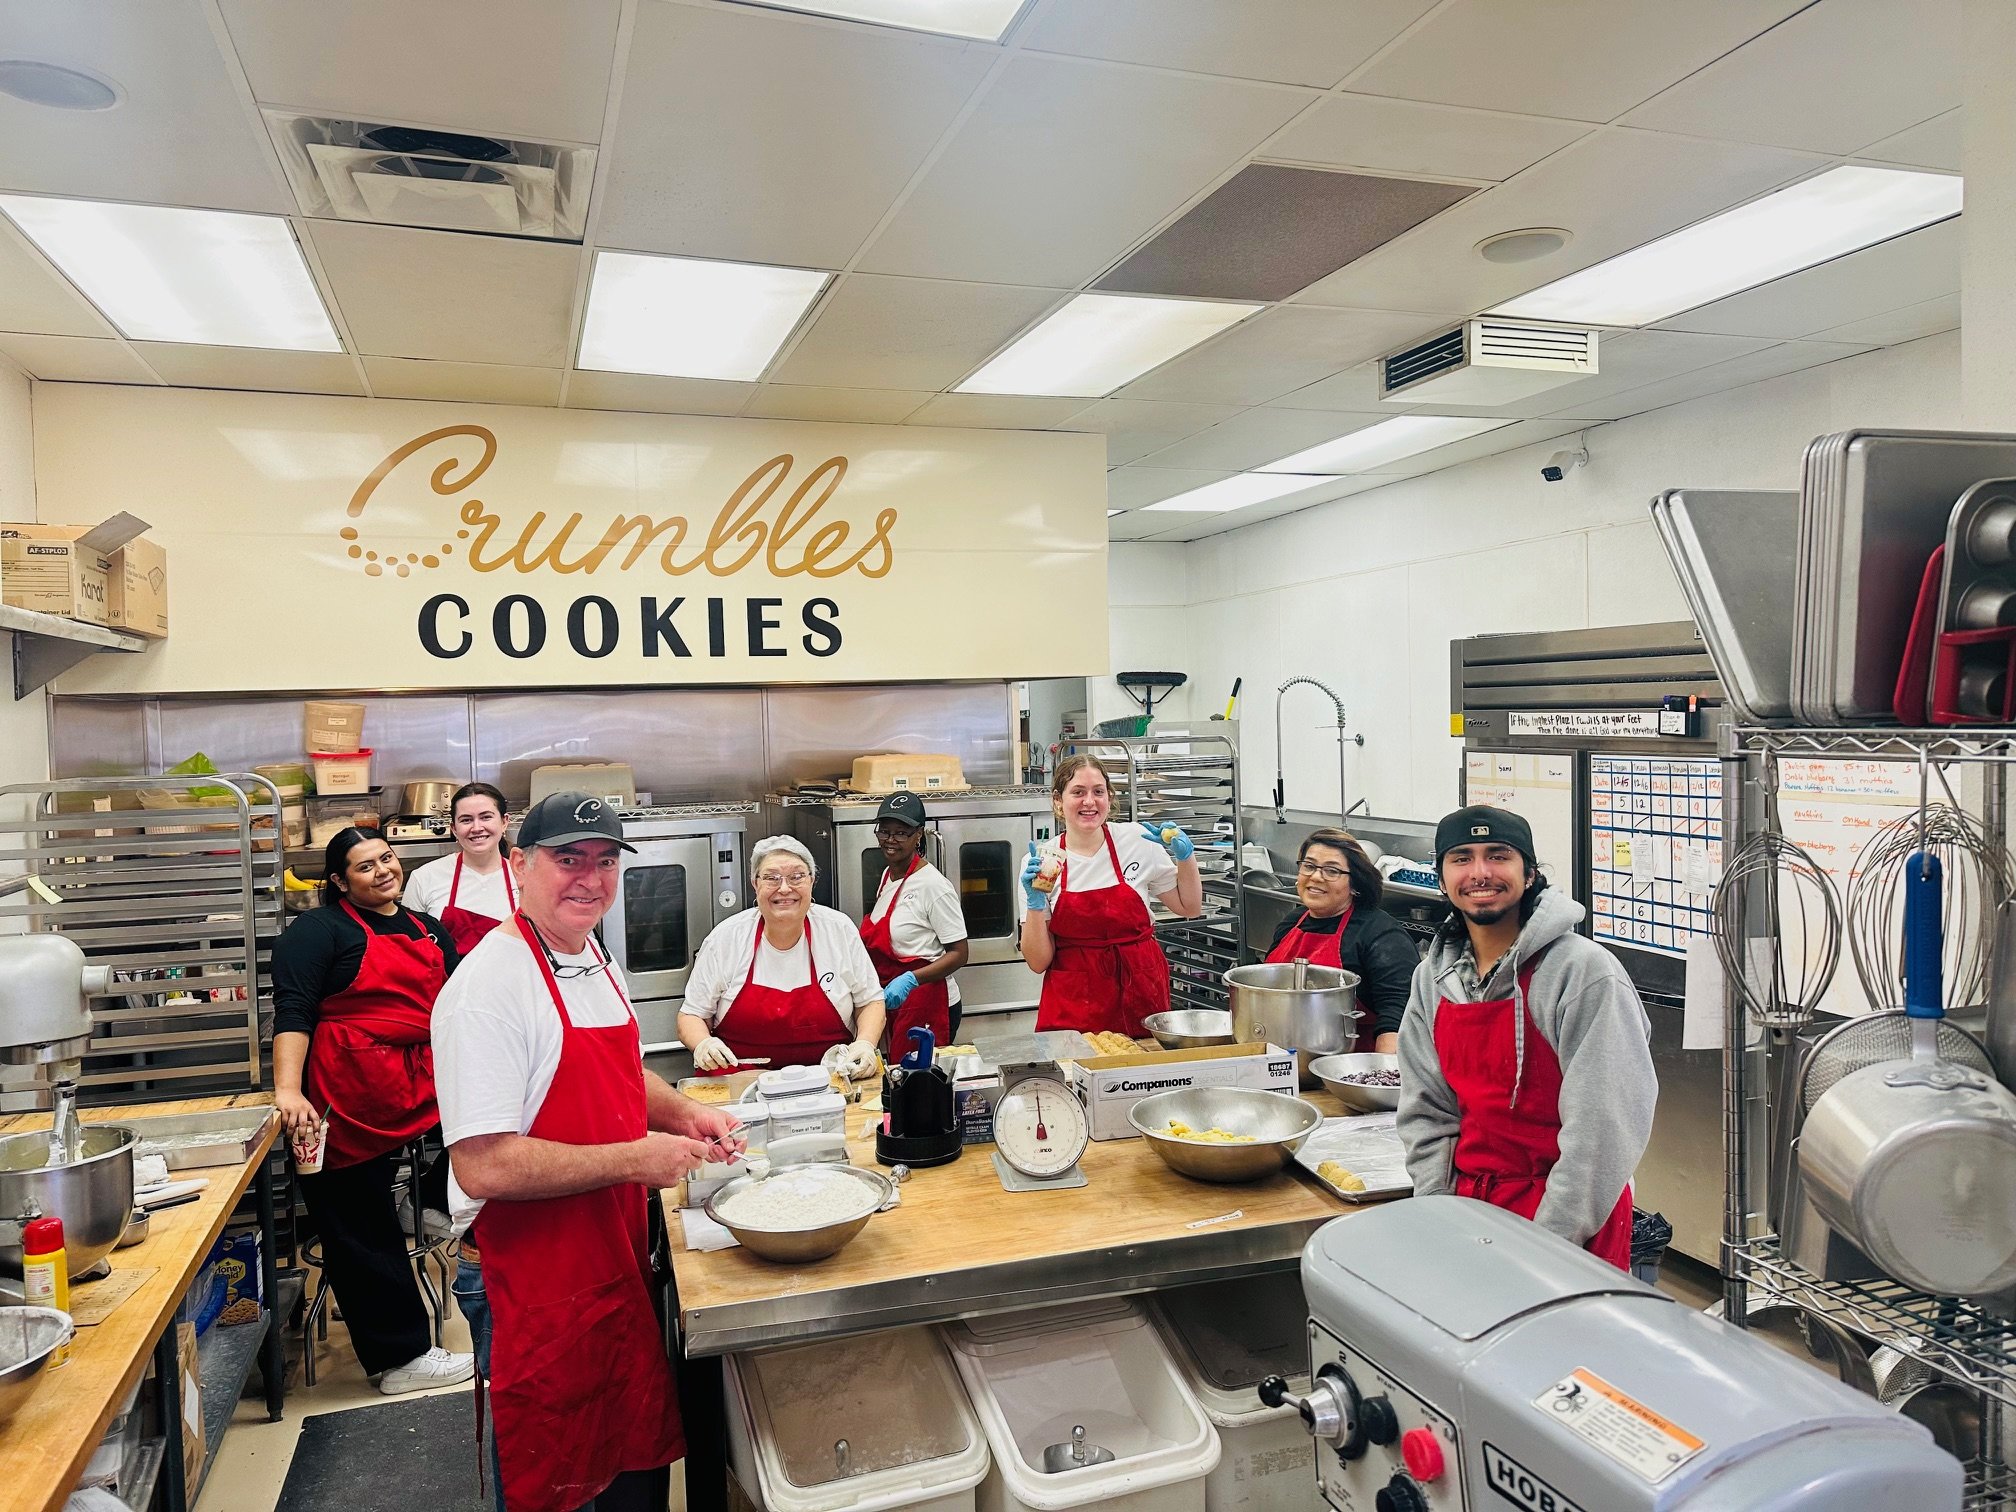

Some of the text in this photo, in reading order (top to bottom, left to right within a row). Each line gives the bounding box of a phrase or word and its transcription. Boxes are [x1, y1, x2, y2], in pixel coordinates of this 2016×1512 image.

[340, 424, 898, 579] Crumbles
[418, 593, 843, 659] COOKIES
[1619, 796, 1627, 808] 5
[1635, 799, 1646, 809] 12
[1637, 906, 1645, 917] 6
[1618, 921, 1627, 936] 8
[1639, 925, 1646, 939] 8
[1121, 1077, 1192, 1092] Companions
[1376, 1374, 1396, 1391] START
[1420, 1407, 1439, 1423] STOP
[1619, 1398, 1667, 1430] WARNING
[1498, 1459, 1573, 1512] HOB
